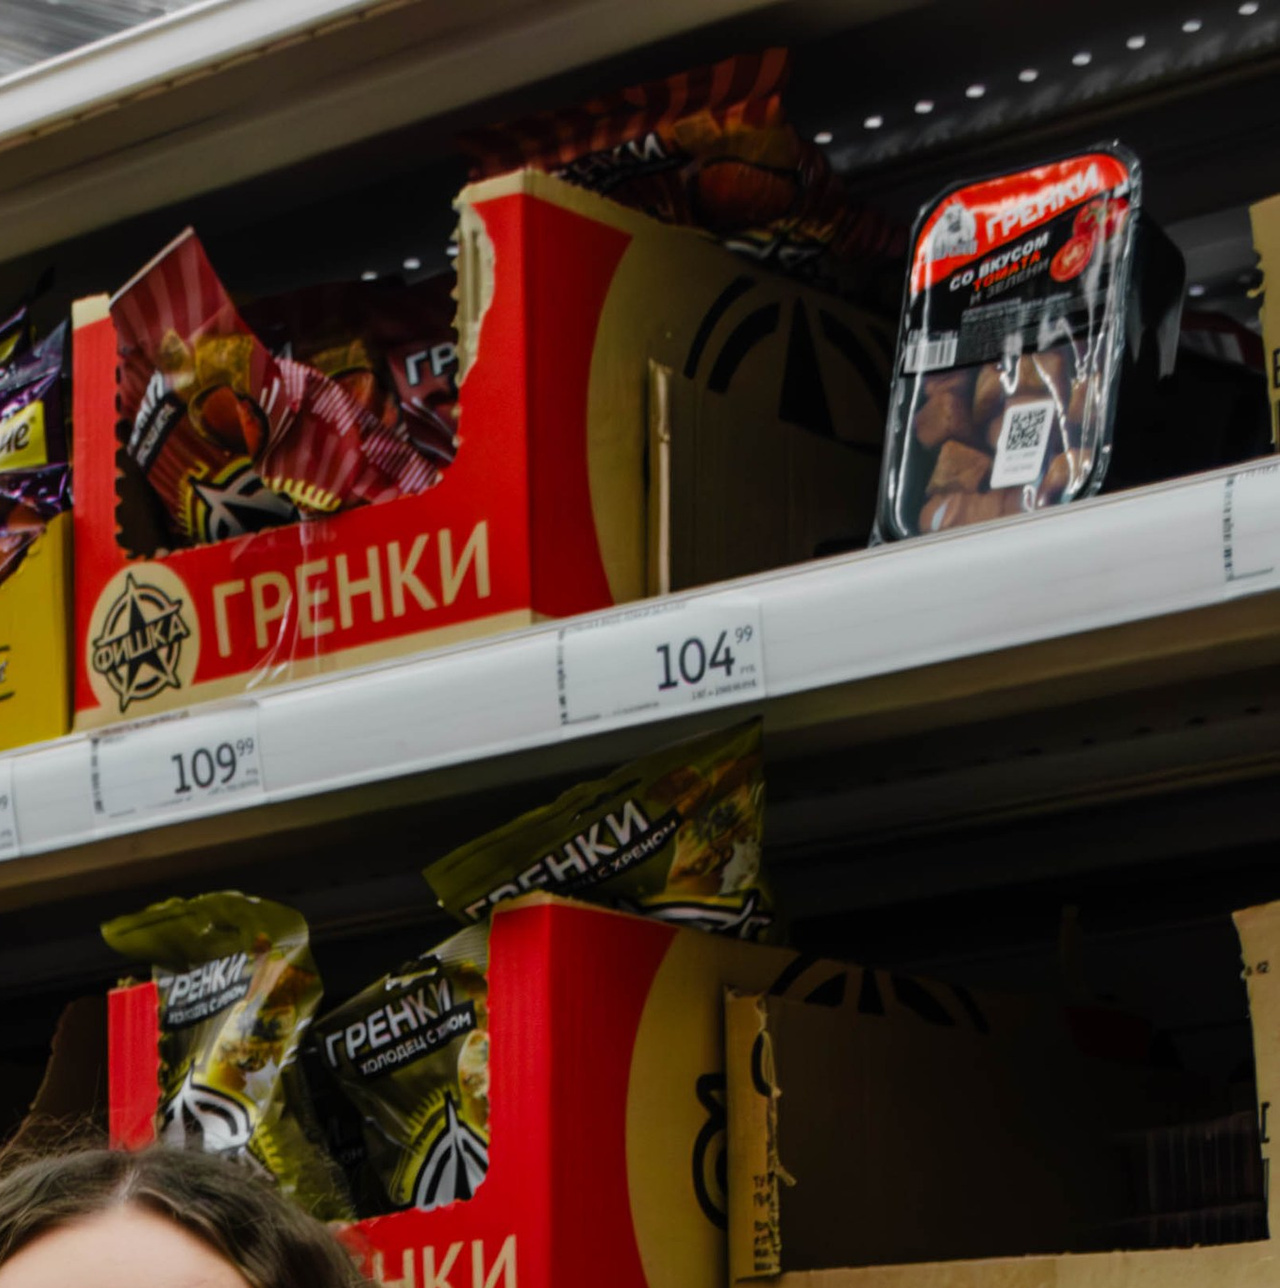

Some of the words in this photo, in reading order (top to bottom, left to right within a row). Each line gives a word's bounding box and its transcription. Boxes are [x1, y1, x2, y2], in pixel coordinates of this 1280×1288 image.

[212, 519, 492, 658] ГРЕНКИ
[93, 610, 190, 674] ФИШКА
[656, 630, 735, 691] 104
[735, 624, 754, 645] 99
[172, 742, 238, 794] 109
[324, 977, 453, 1068] ГРЕНКИ
